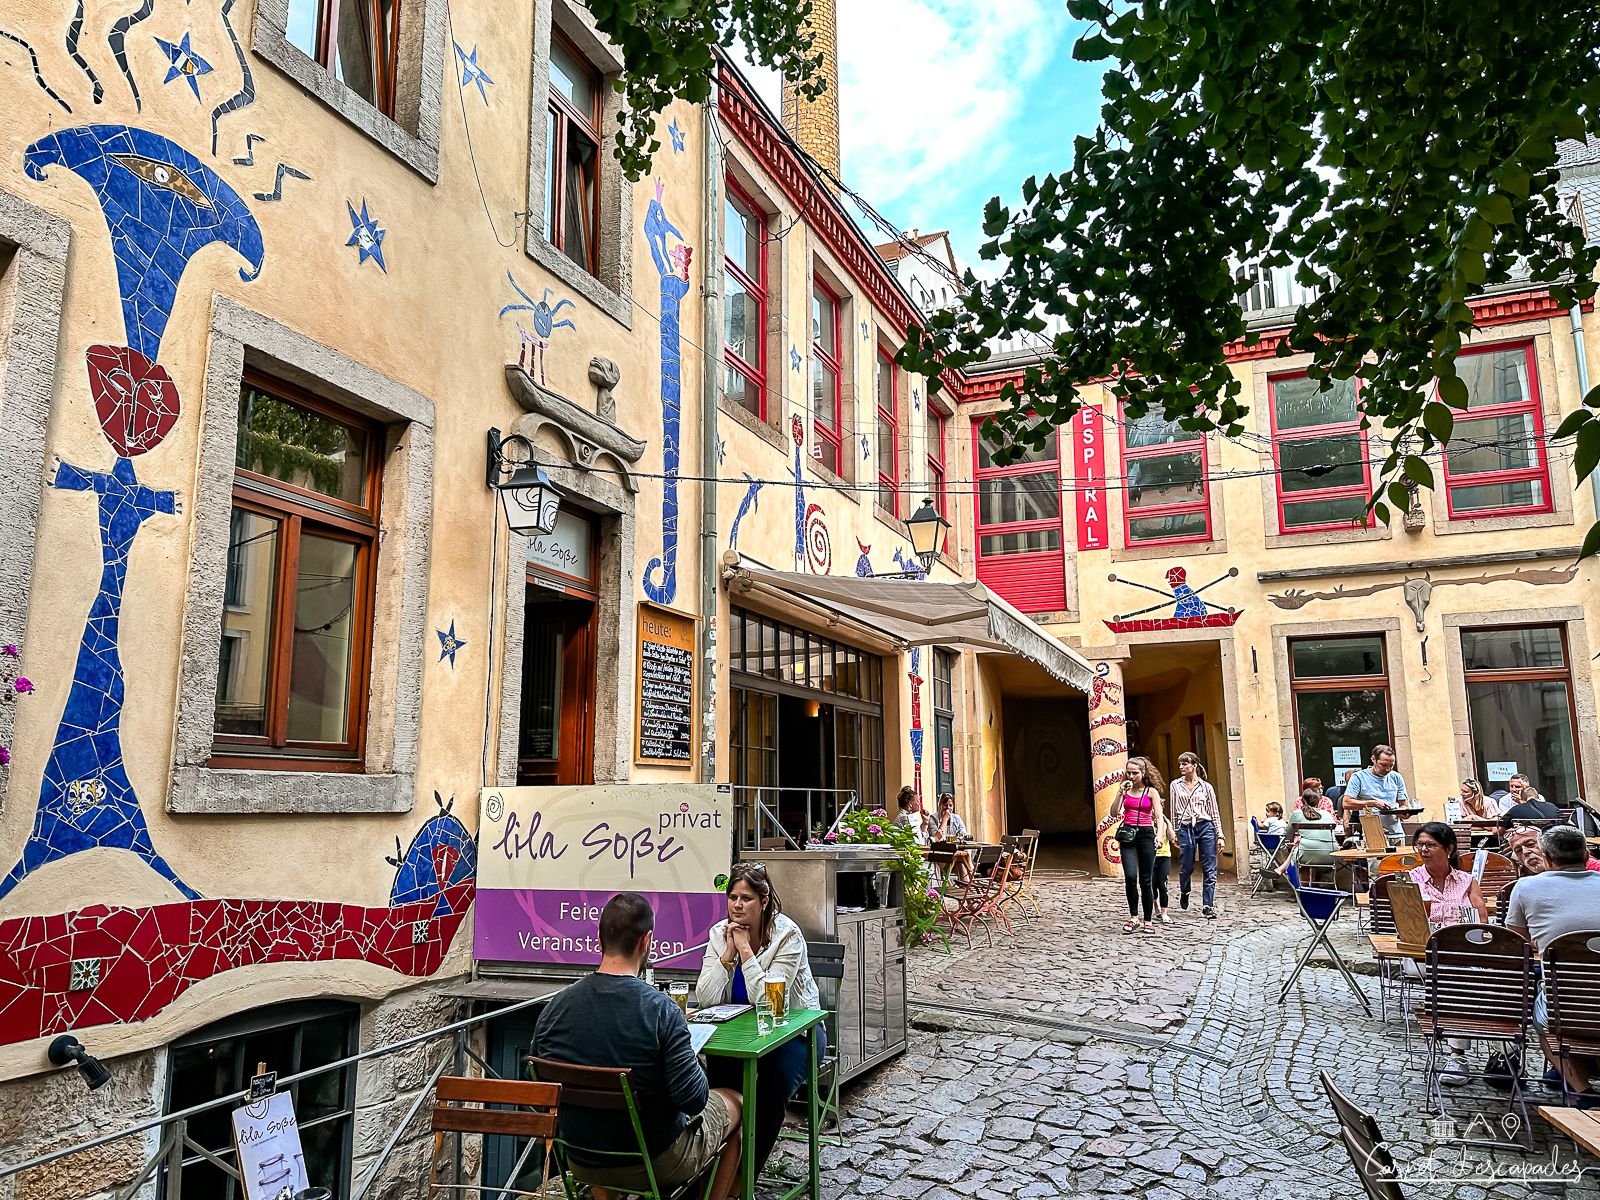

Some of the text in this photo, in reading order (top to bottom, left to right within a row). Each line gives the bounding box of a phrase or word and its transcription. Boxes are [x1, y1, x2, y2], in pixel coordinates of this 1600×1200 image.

[1082, 409, 1098, 542] ESPIRAL
[642, 616, 672, 638] heute:
[659, 802, 722, 834] privat
[493, 811, 684, 879] lila Soße
[239, 1126, 263, 1144] lila
